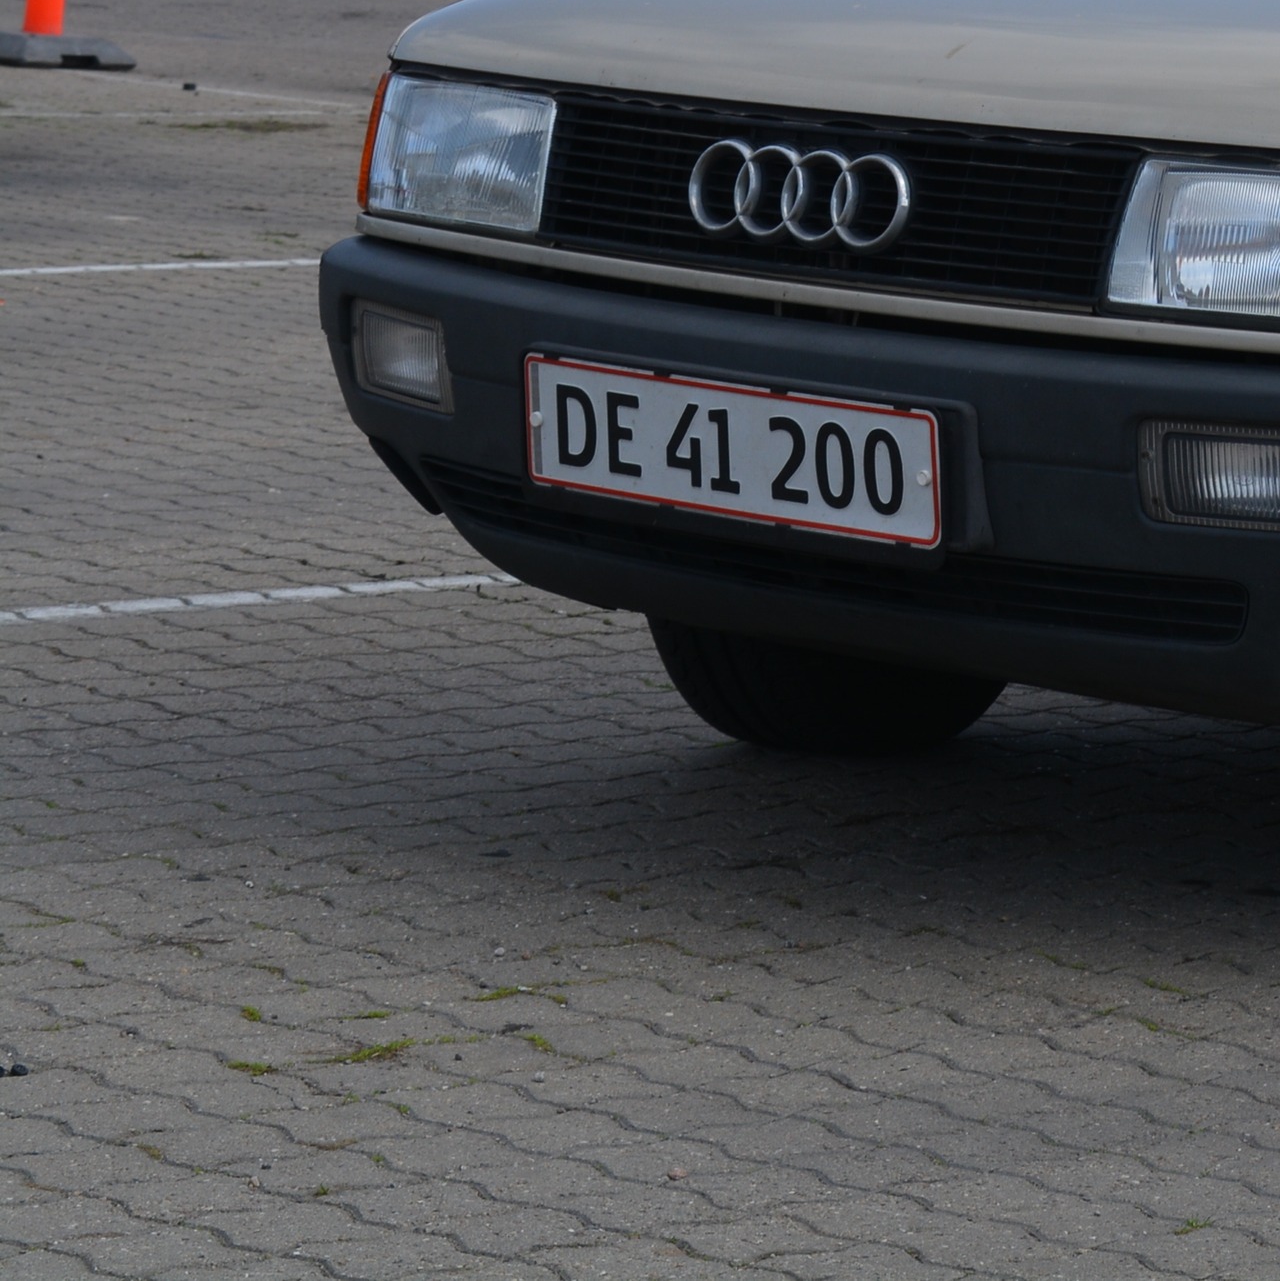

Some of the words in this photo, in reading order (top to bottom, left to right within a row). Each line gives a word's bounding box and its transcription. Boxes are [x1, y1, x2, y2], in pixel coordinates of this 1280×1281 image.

[555, 383, 643, 478] DE
[665, 402, 741, 496] 41
[768, 415, 905, 516] 200
